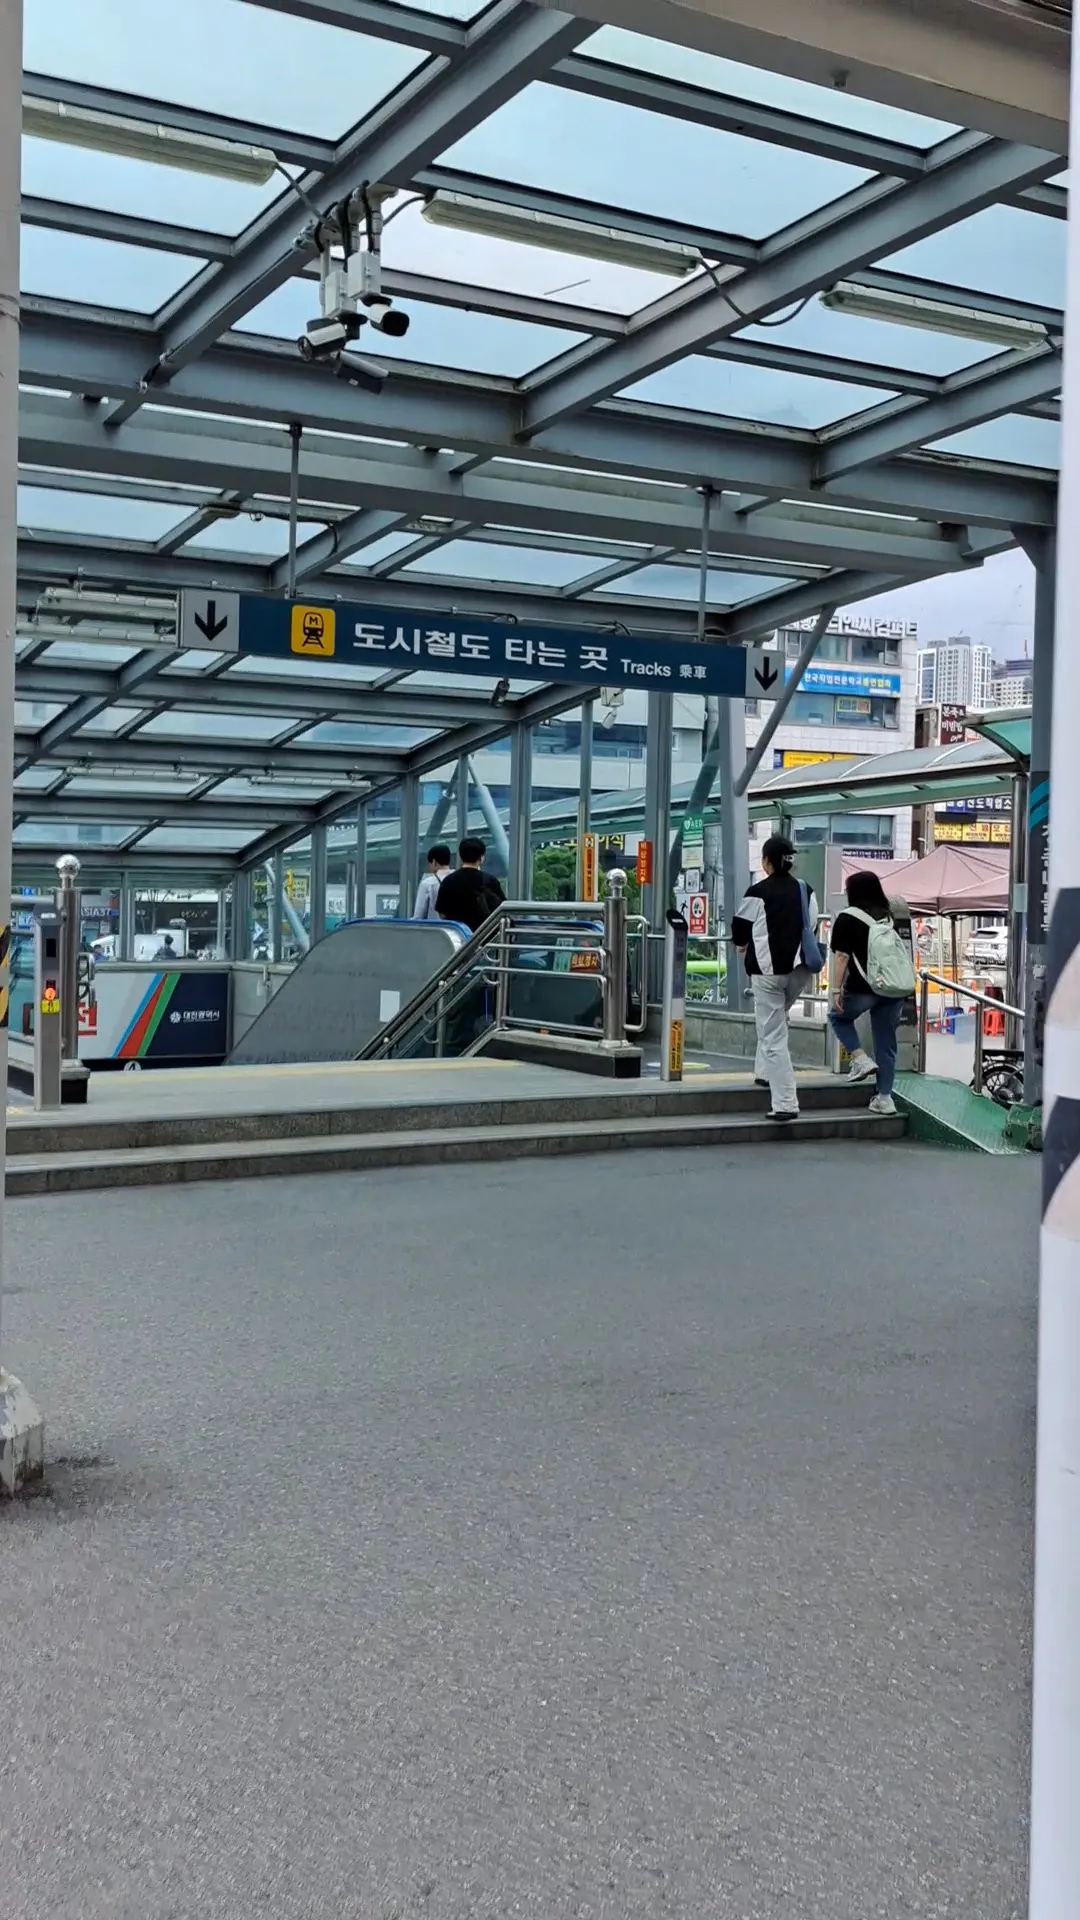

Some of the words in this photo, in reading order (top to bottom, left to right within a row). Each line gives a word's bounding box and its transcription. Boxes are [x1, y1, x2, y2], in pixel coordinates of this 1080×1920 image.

[352, 622, 491, 660] 도시철도
[504, 638, 567, 668] 타는
[579, 645, 608, 671] 곳
[620, 658, 672, 678] Tracks
